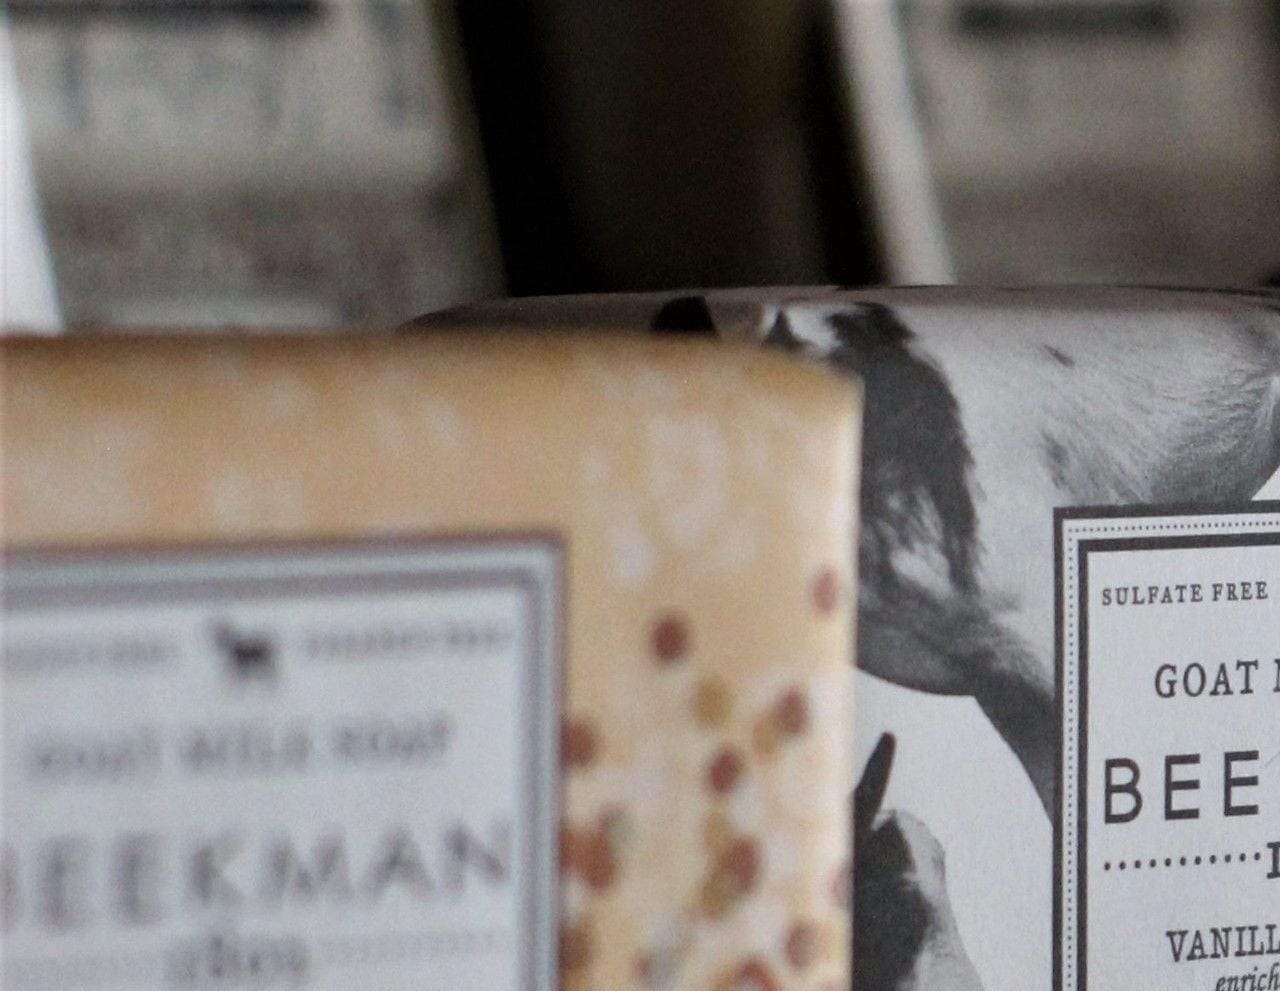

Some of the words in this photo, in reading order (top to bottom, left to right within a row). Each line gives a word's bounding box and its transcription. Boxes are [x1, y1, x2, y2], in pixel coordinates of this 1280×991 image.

[1102, 584, 1203, 606] SULFATE
[1212, 581, 1268, 602] FREE
[1154, 660, 1259, 698] GOAT
